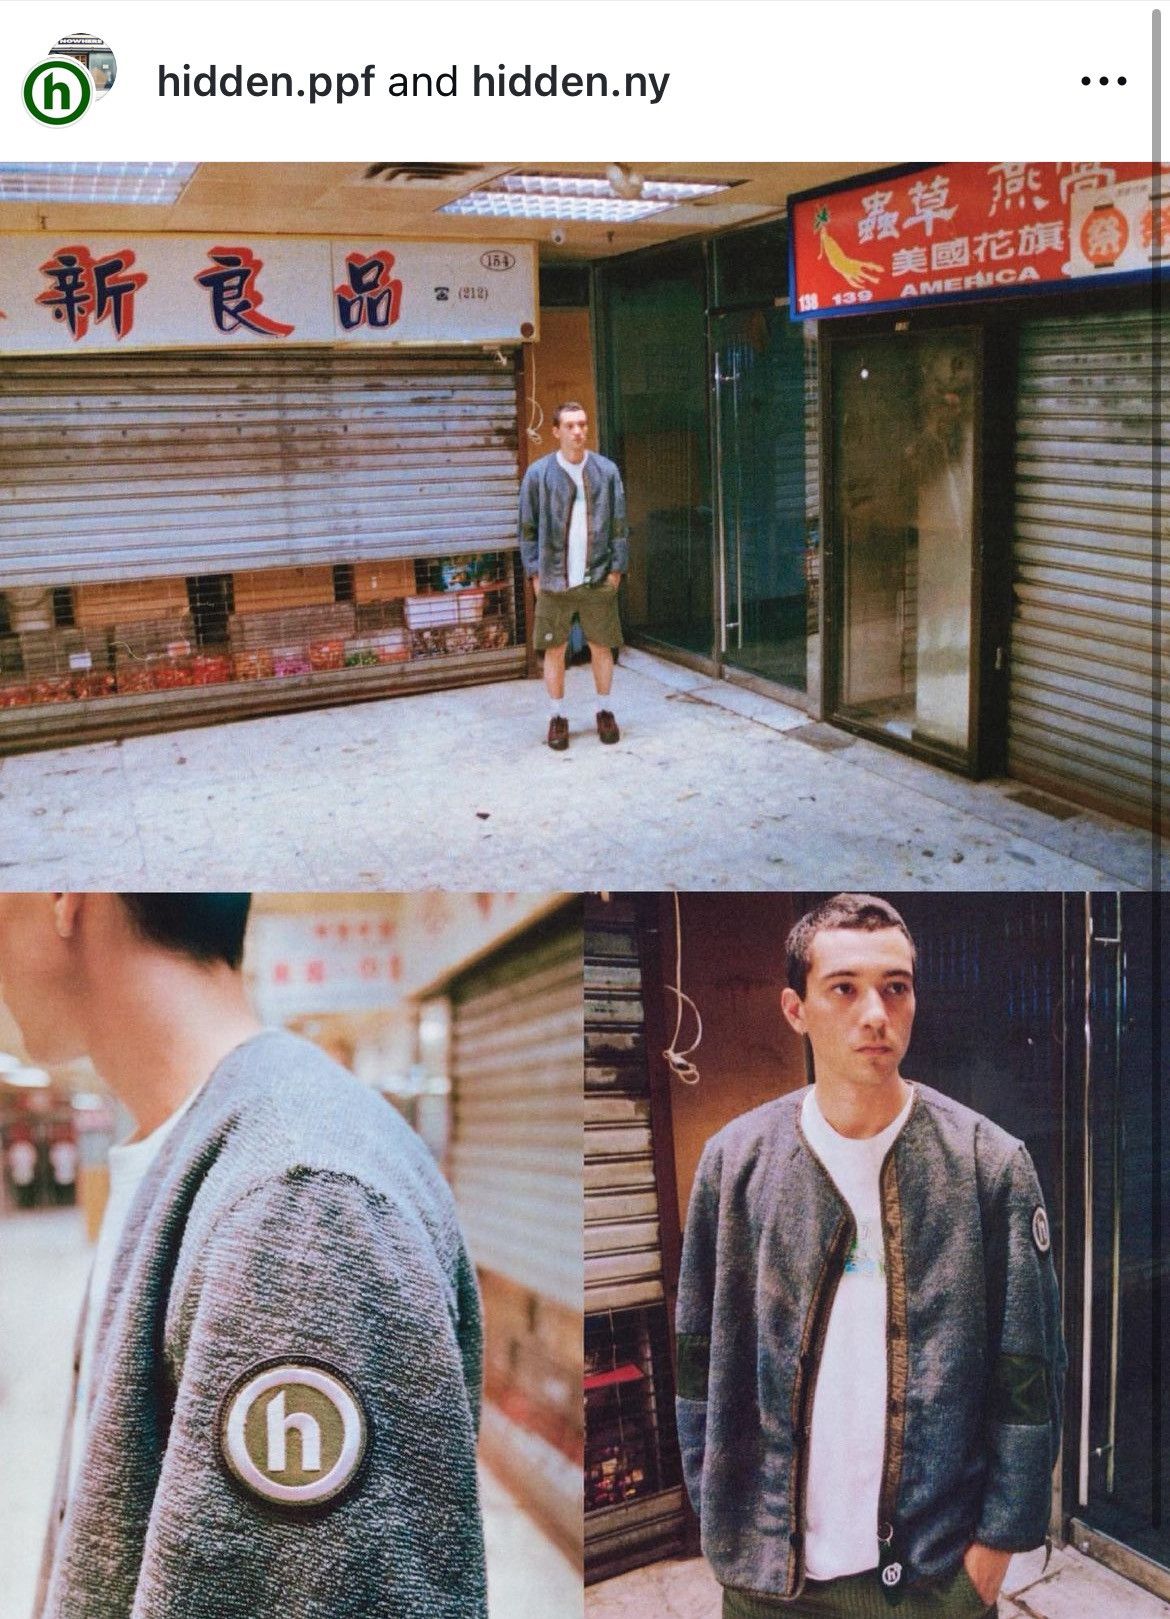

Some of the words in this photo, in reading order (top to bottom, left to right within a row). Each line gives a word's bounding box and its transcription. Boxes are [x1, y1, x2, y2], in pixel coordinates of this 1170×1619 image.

[892, 220, 1065, 277] 美國花旗
[35, 245, 402, 341] 新良品
[458, 286, 489, 300] (212)
[832, 290, 873, 305] 139
[900, 266, 1041, 298] AMERICA
[266, 1389, 321, 1472] h
